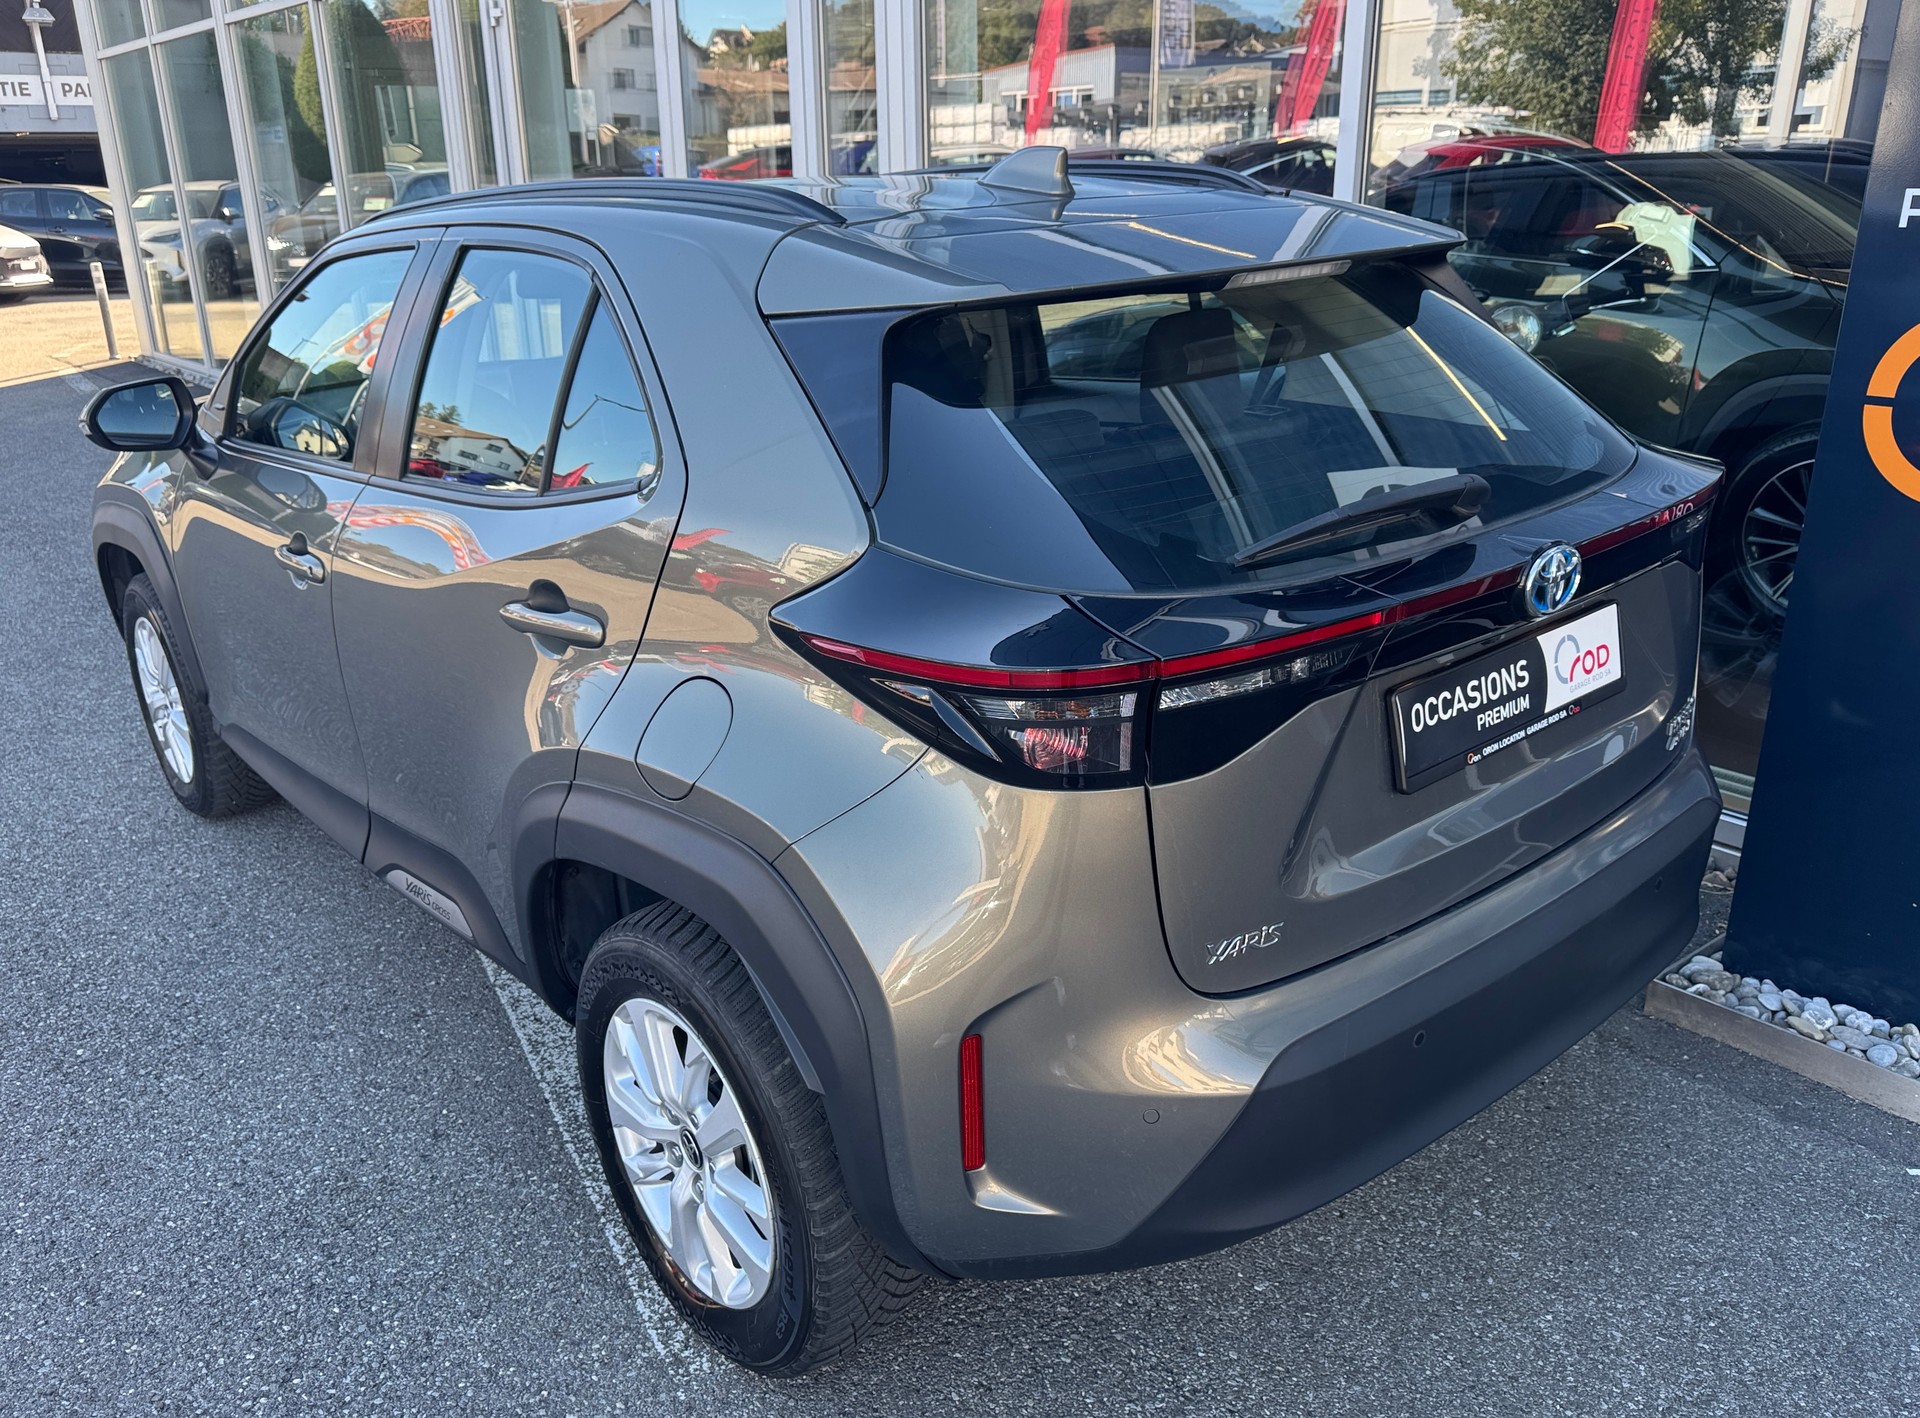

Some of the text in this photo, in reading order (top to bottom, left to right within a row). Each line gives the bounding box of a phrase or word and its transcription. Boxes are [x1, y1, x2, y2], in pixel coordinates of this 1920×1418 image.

[0, 81, 92, 98] TIE PA
[1411, 659, 1530, 733] OCCASIONS
[1477, 693, 1530, 731] PREMIUM
[1482, 742, 1500, 756] ORON
[1499, 729, 1526, 749] LOCATION
[1526, 718, 1549, 735] GARAGE
[1548, 713, 1560, 725] ROD
[1559, 709, 1568, 719] SA
[431, 902, 451, 921] CROSS
